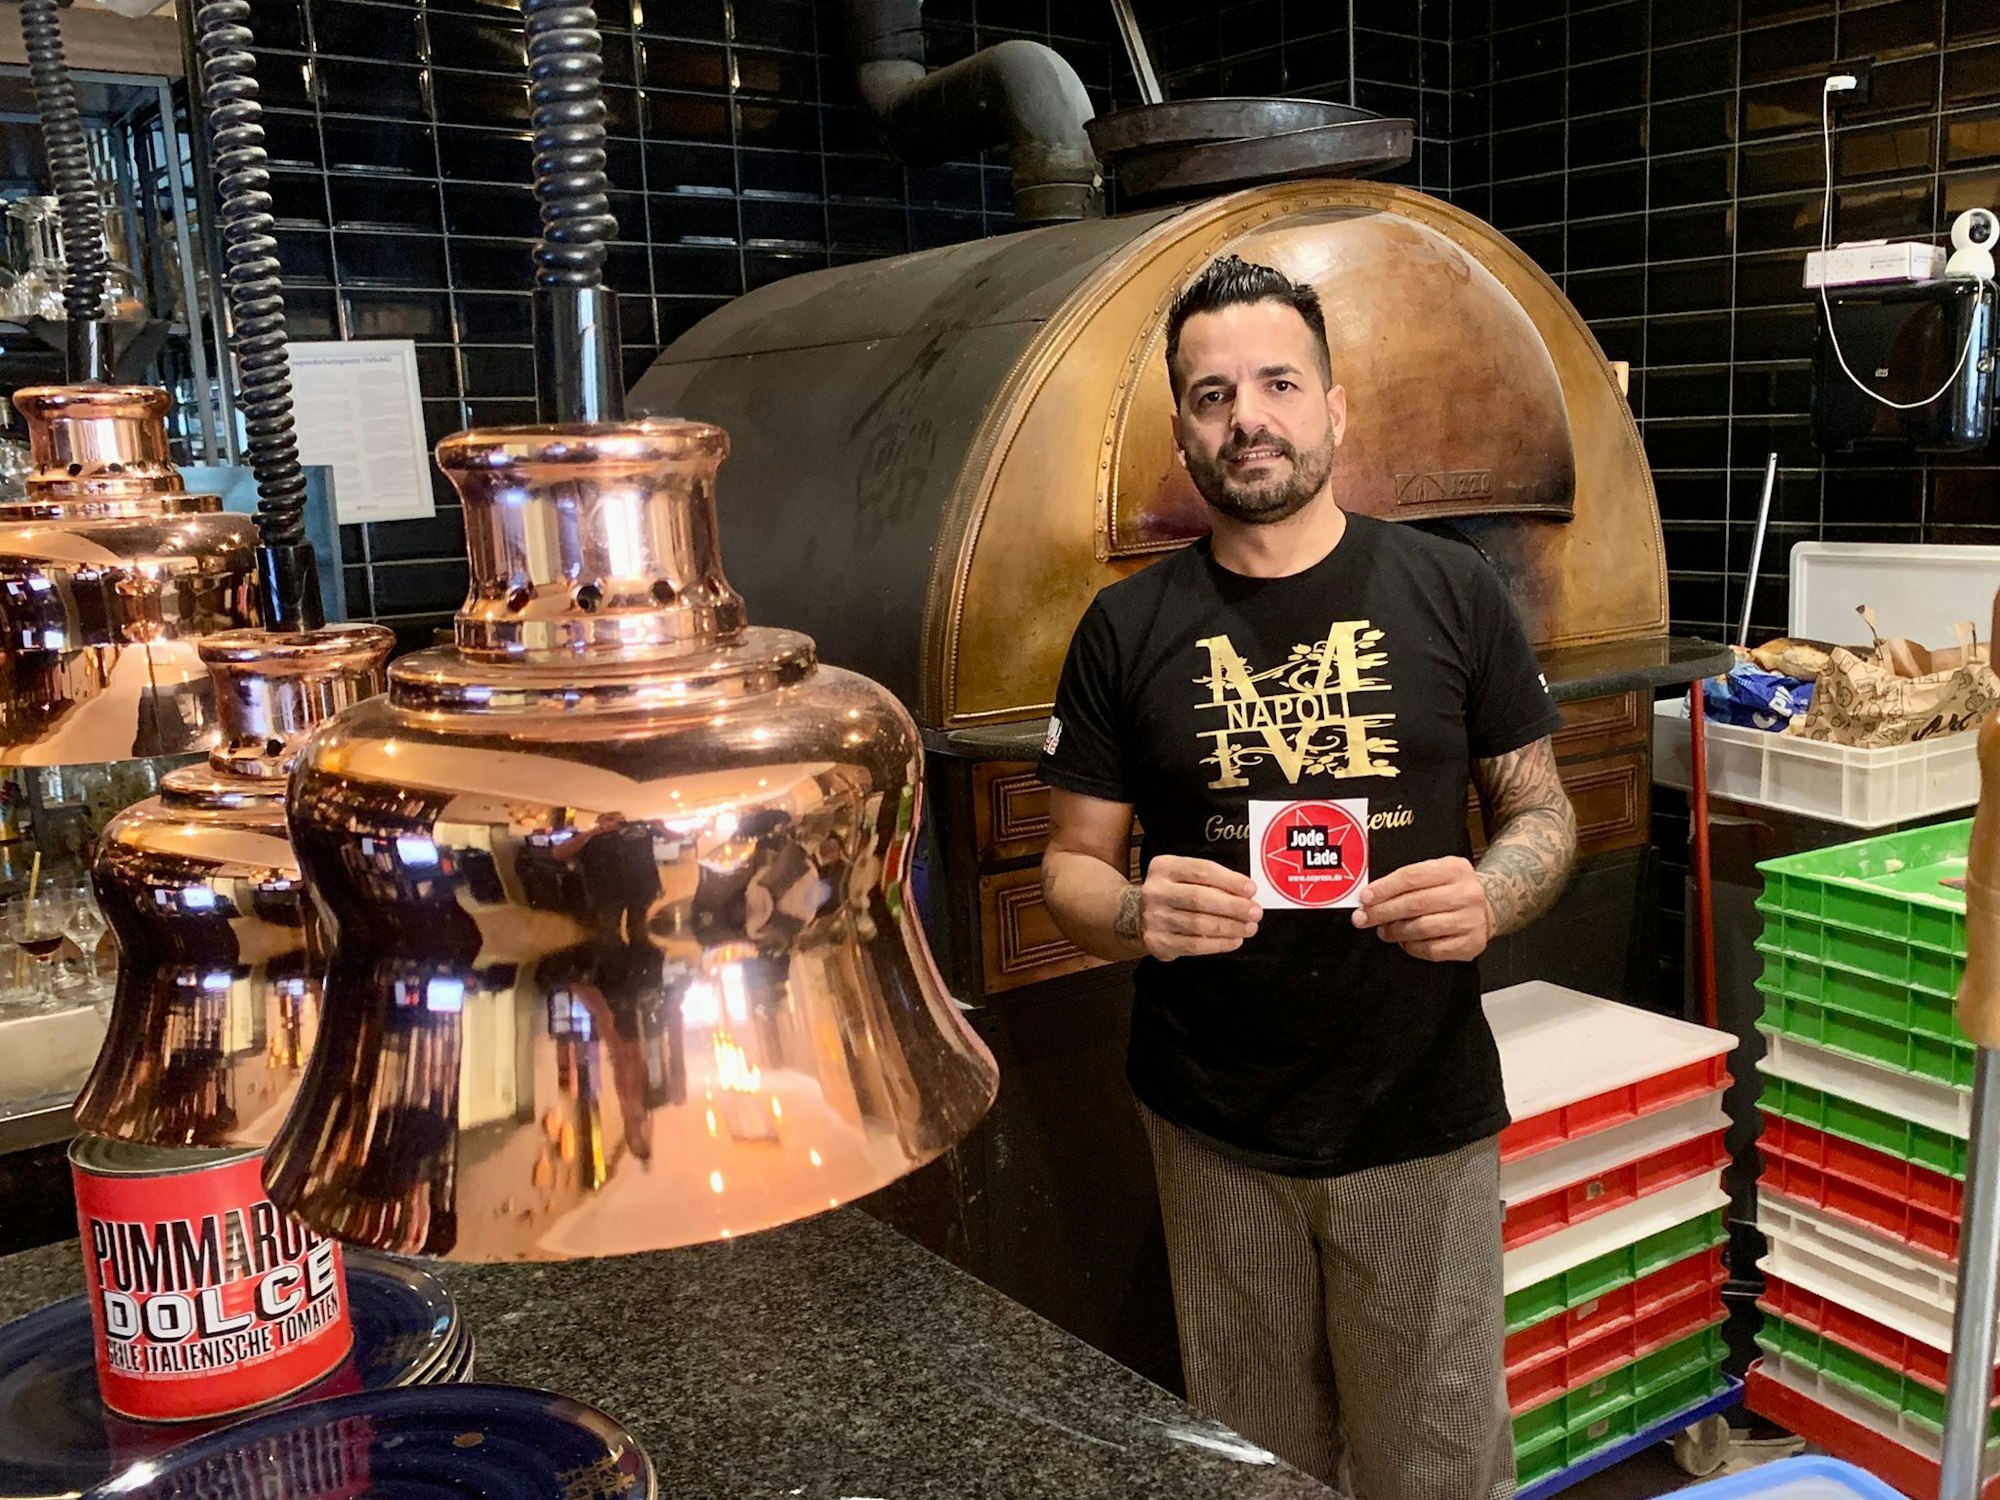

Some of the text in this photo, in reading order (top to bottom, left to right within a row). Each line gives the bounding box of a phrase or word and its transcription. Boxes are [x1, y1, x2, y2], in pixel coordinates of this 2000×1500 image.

[1227, 689, 1350, 731] NAPOLI
[1205, 814, 1250, 842] Gou
[1290, 829, 1325, 847] Jode
[1306, 849, 1338, 866] Lade
[91, 1201, 326, 1294] PUMMARO
[102, 1239, 335, 1344] DOLCE
[144, 1326, 272, 1373] ITALIENISCHE
[273, 1291, 340, 1347] TOMATEN
